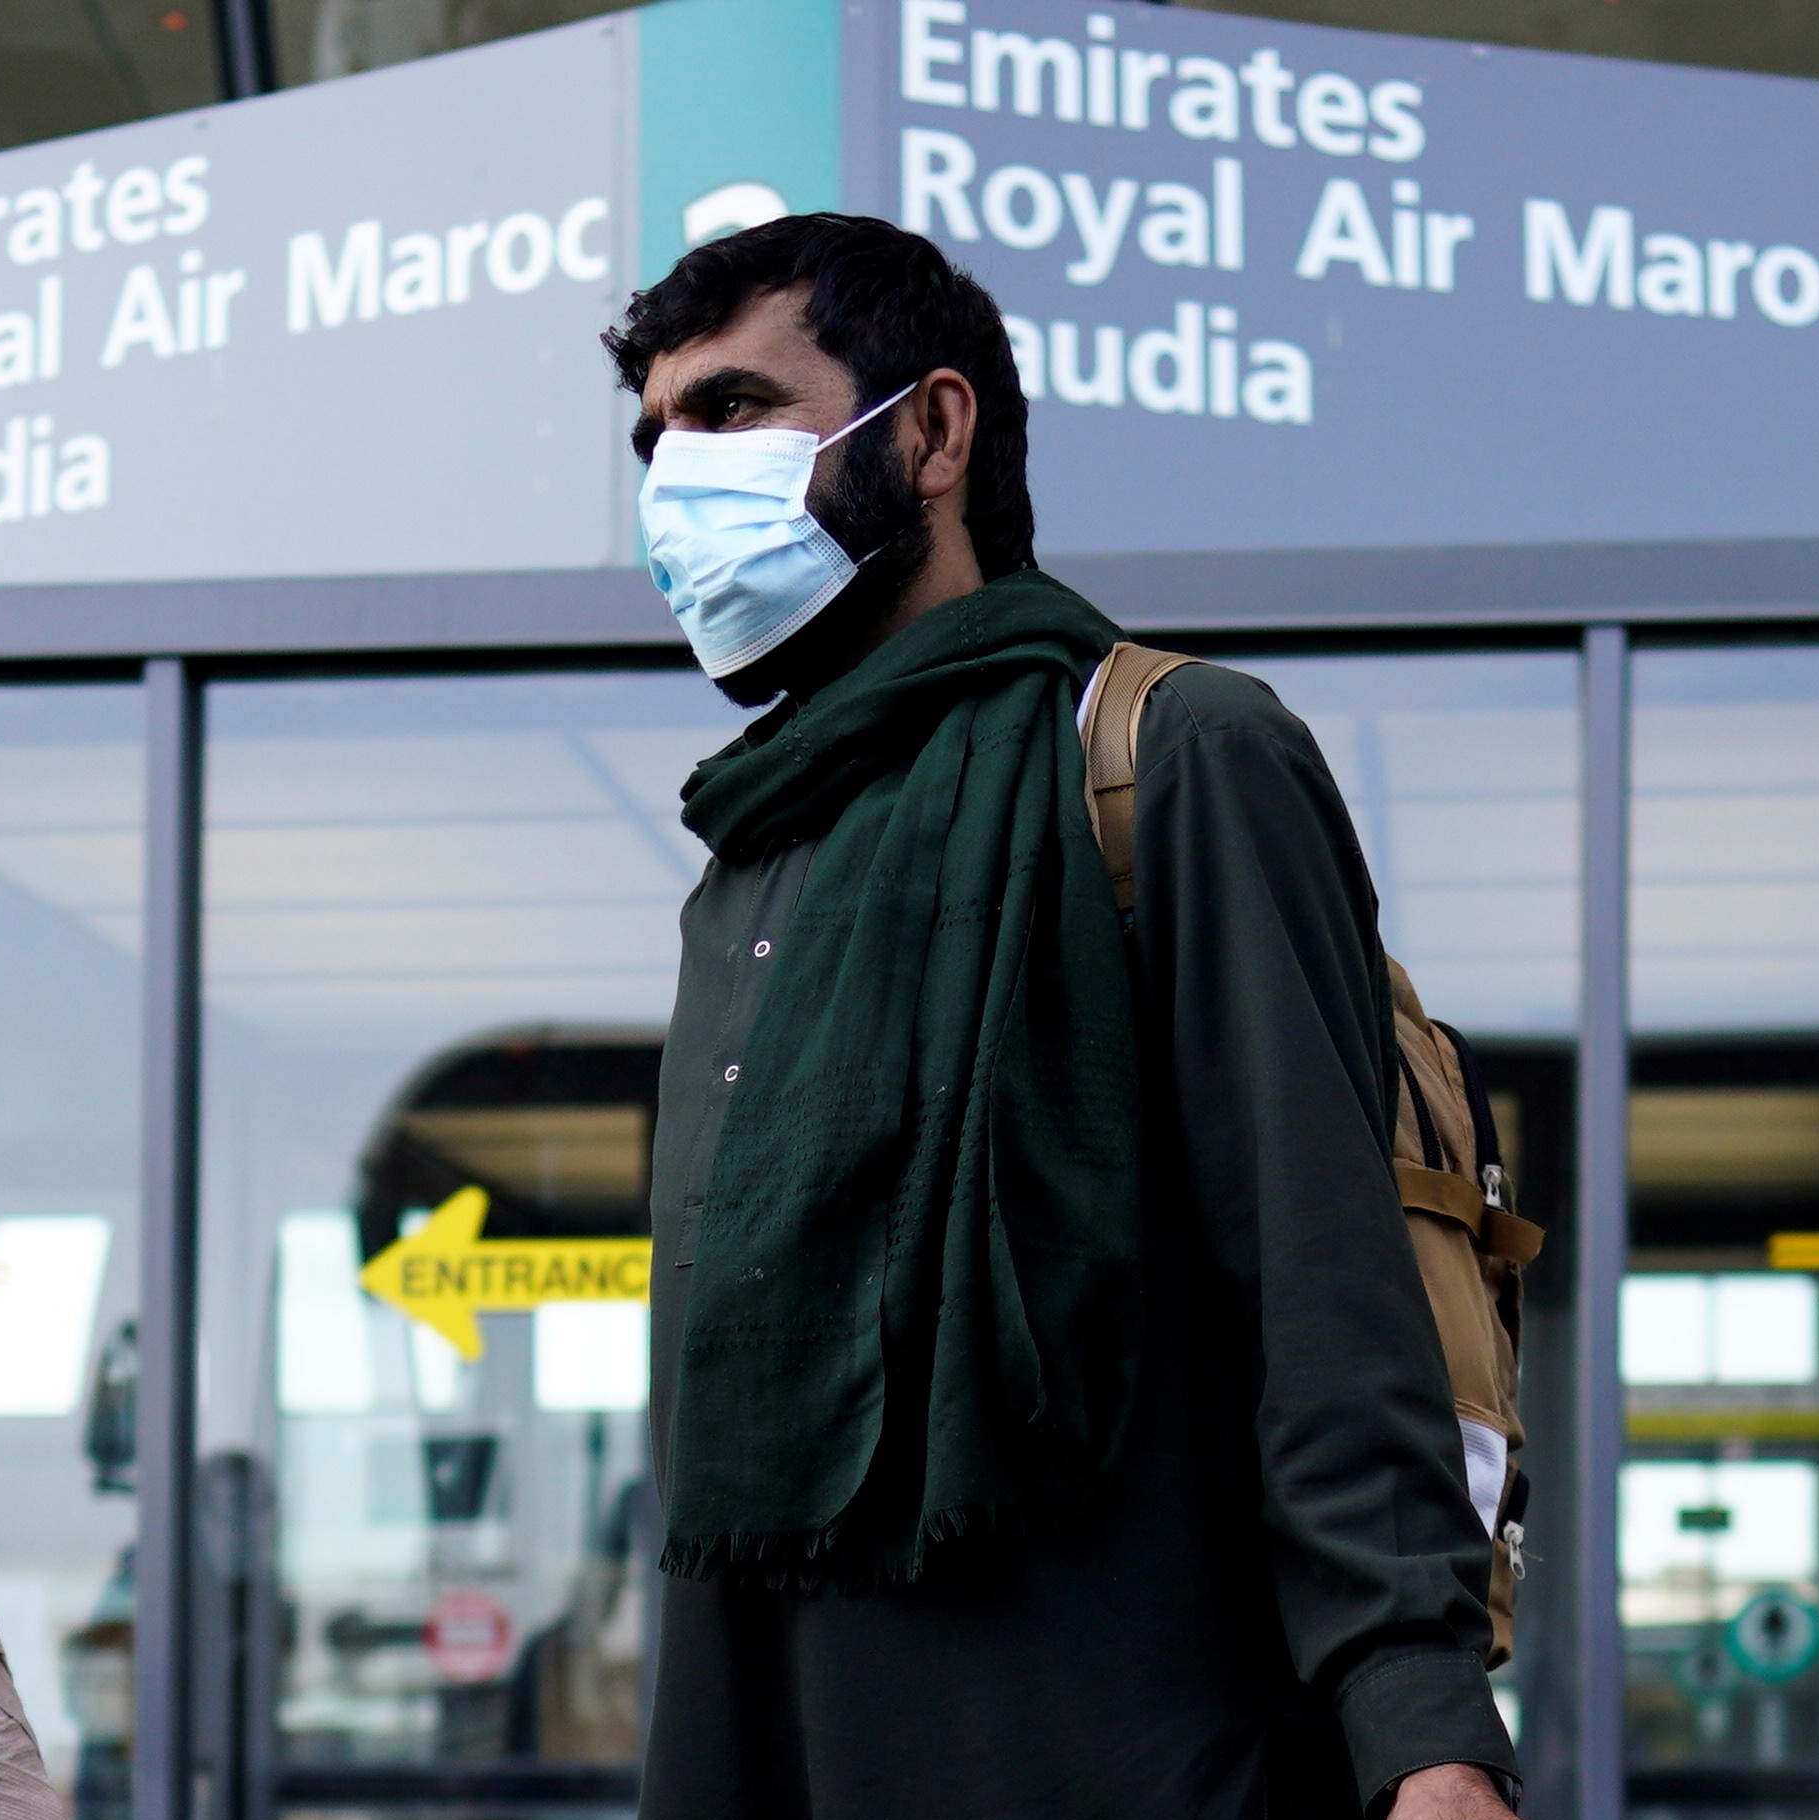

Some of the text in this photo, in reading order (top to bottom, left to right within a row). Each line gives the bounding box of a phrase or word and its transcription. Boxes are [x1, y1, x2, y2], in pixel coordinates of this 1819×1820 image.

[900, 0, 1427, 163] Emirates
[99, 250, 247, 368] Air
[286, 197, 610, 334] Maroc
[900, 127, 1244, 286] Royal
[1296, 178, 1475, 292] Air
[998, 299, 1314, 425] audia
[401, 1252, 650, 1297] ENTRANC
